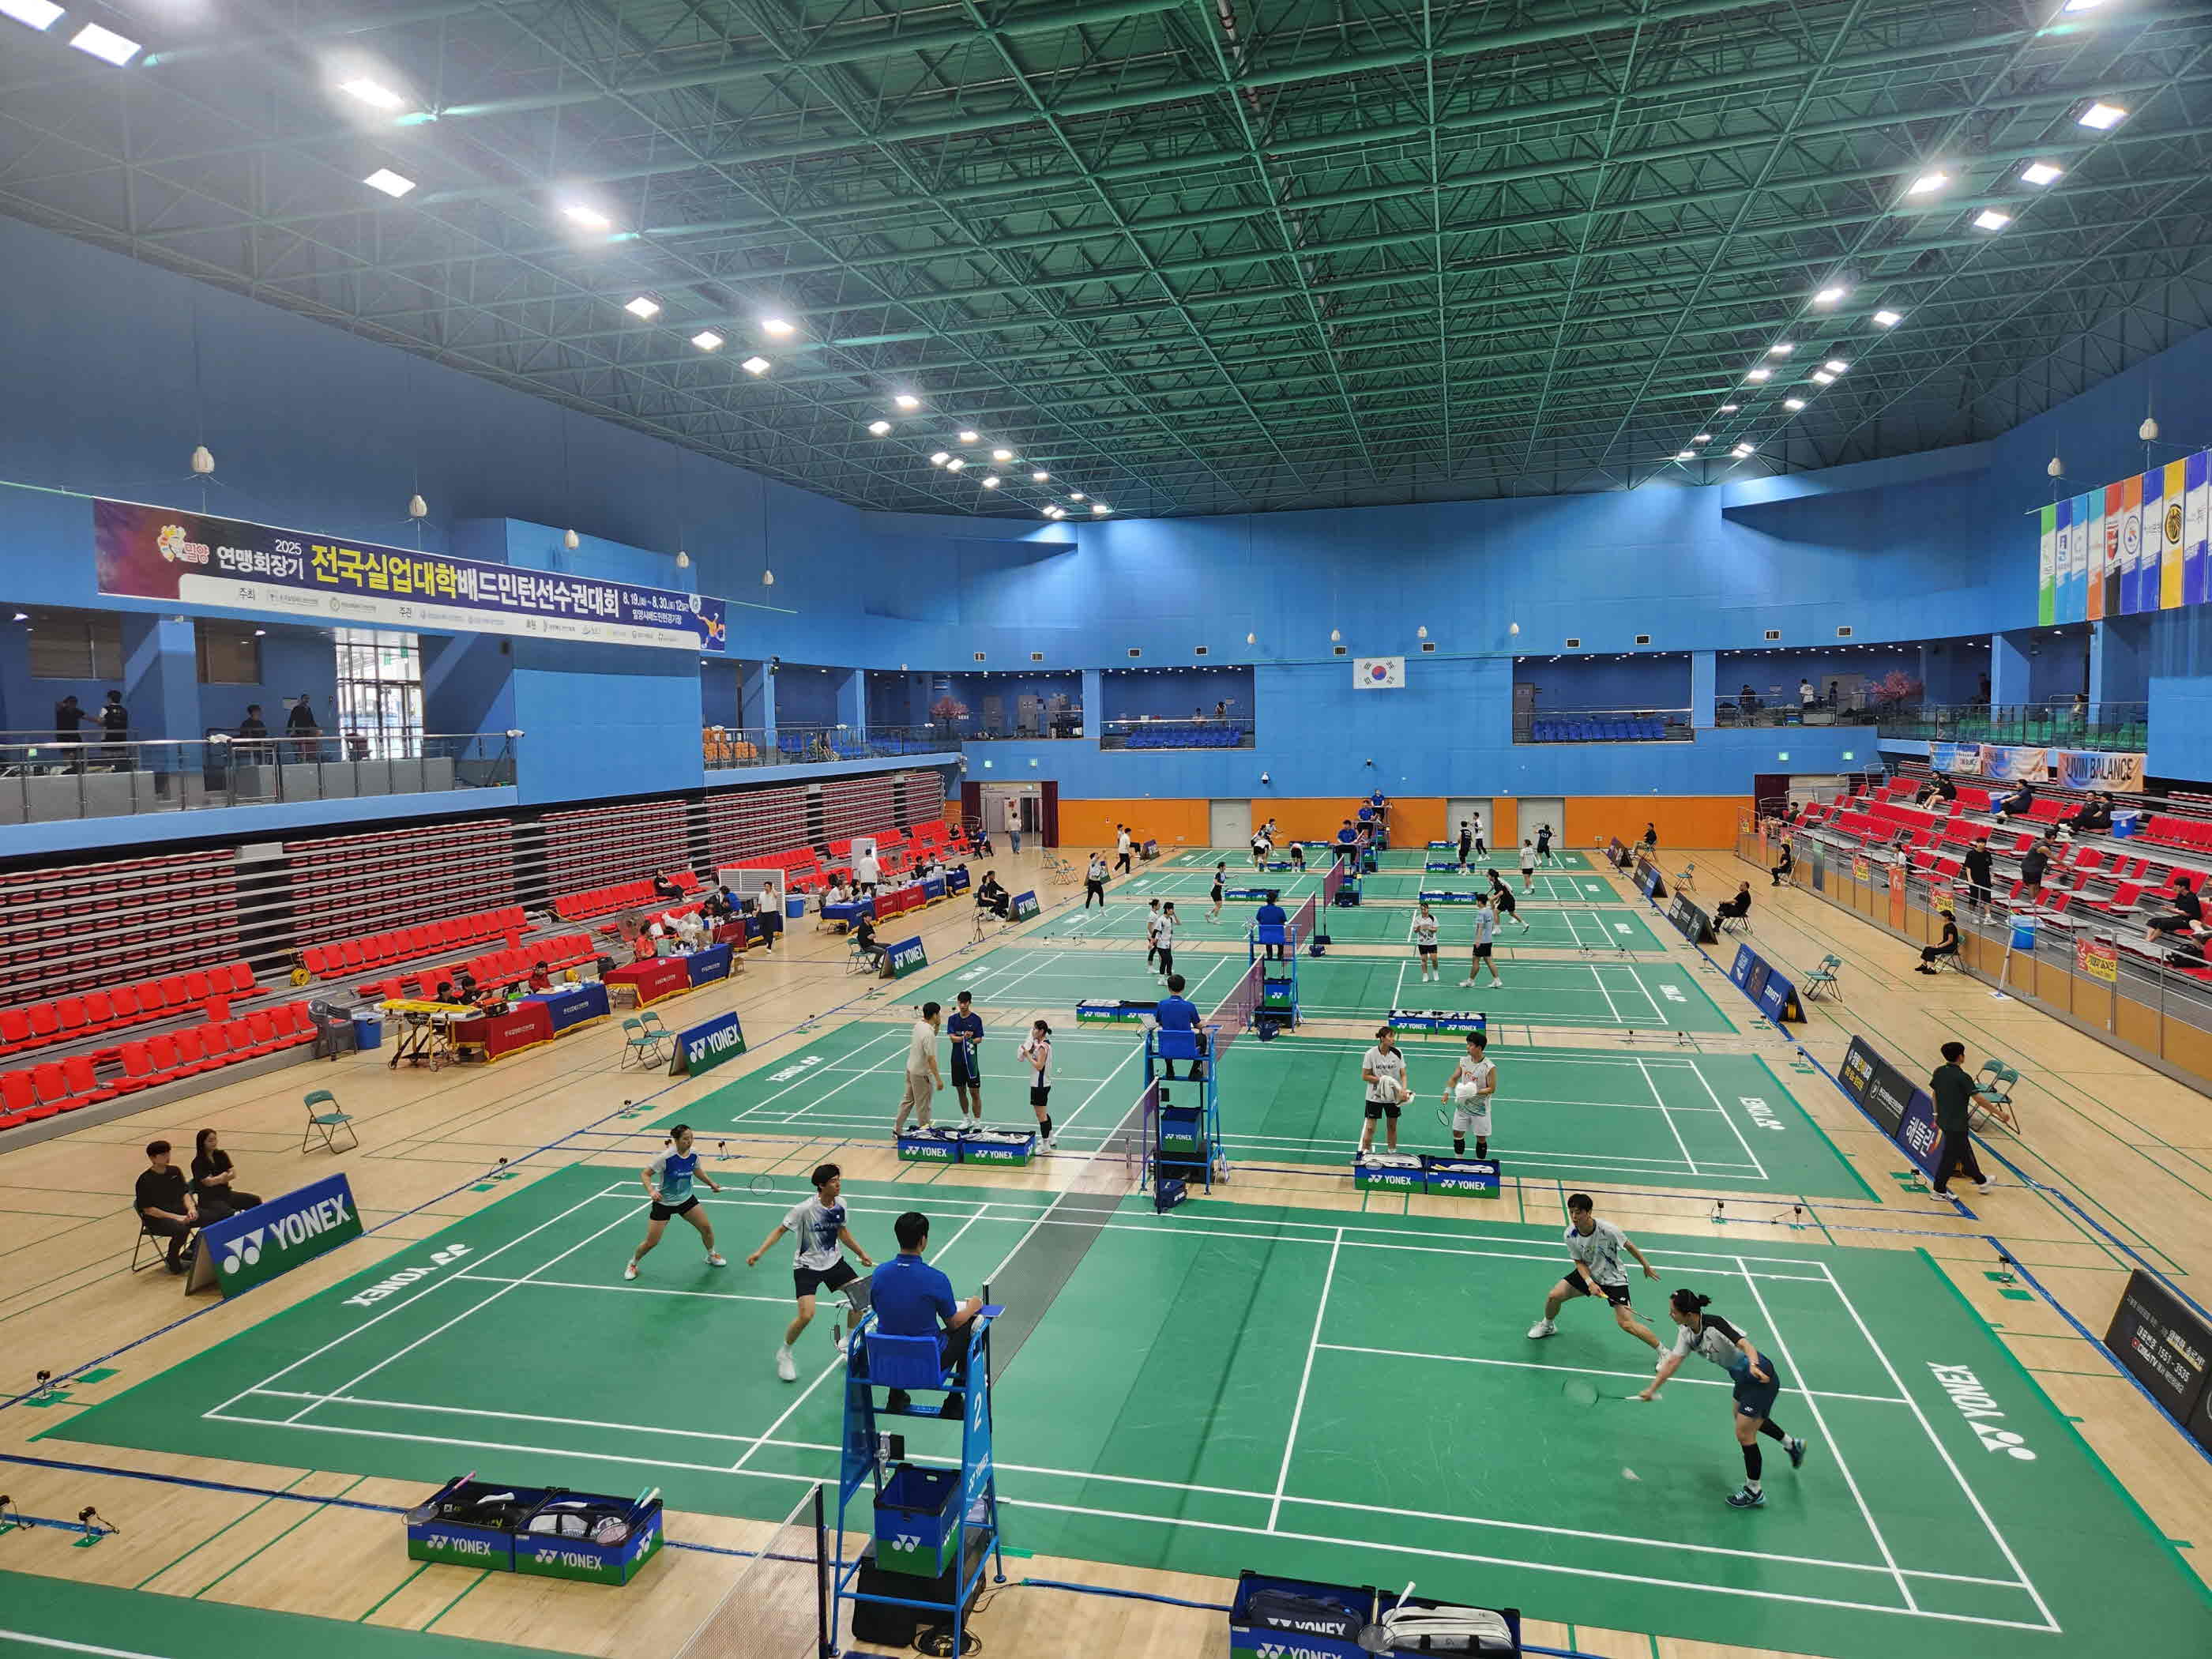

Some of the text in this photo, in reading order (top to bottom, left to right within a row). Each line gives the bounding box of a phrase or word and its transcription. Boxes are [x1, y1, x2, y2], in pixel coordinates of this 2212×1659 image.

[276, 539, 302, 555] 2025
[216, 546, 303, 580] 연맹회장기
[2090, 758, 2133, 781] BALANCE
[904, 944, 924, 965] YONEX
[706, 1024, 741, 1054] YONEX
[921, 1146, 947, 1157] YONEX
[989, 1149, 1013, 1160] YONEX
[1385, 1176, 1411, 1186] YONEX
[1458, 1180, 1485, 1191] YONEX
[269, 1194, 352, 1251] YONEX
[341, 1266, 438, 1307] YONEX
[2136, 1325, 2157, 1350] 대표번호
[1926, 1360, 2005, 1418] YONEX
[974, 1391, 982, 1432] 2
[452, 1537, 491, 1556] YONEX
[561, 1551, 603, 1571] YONEX
